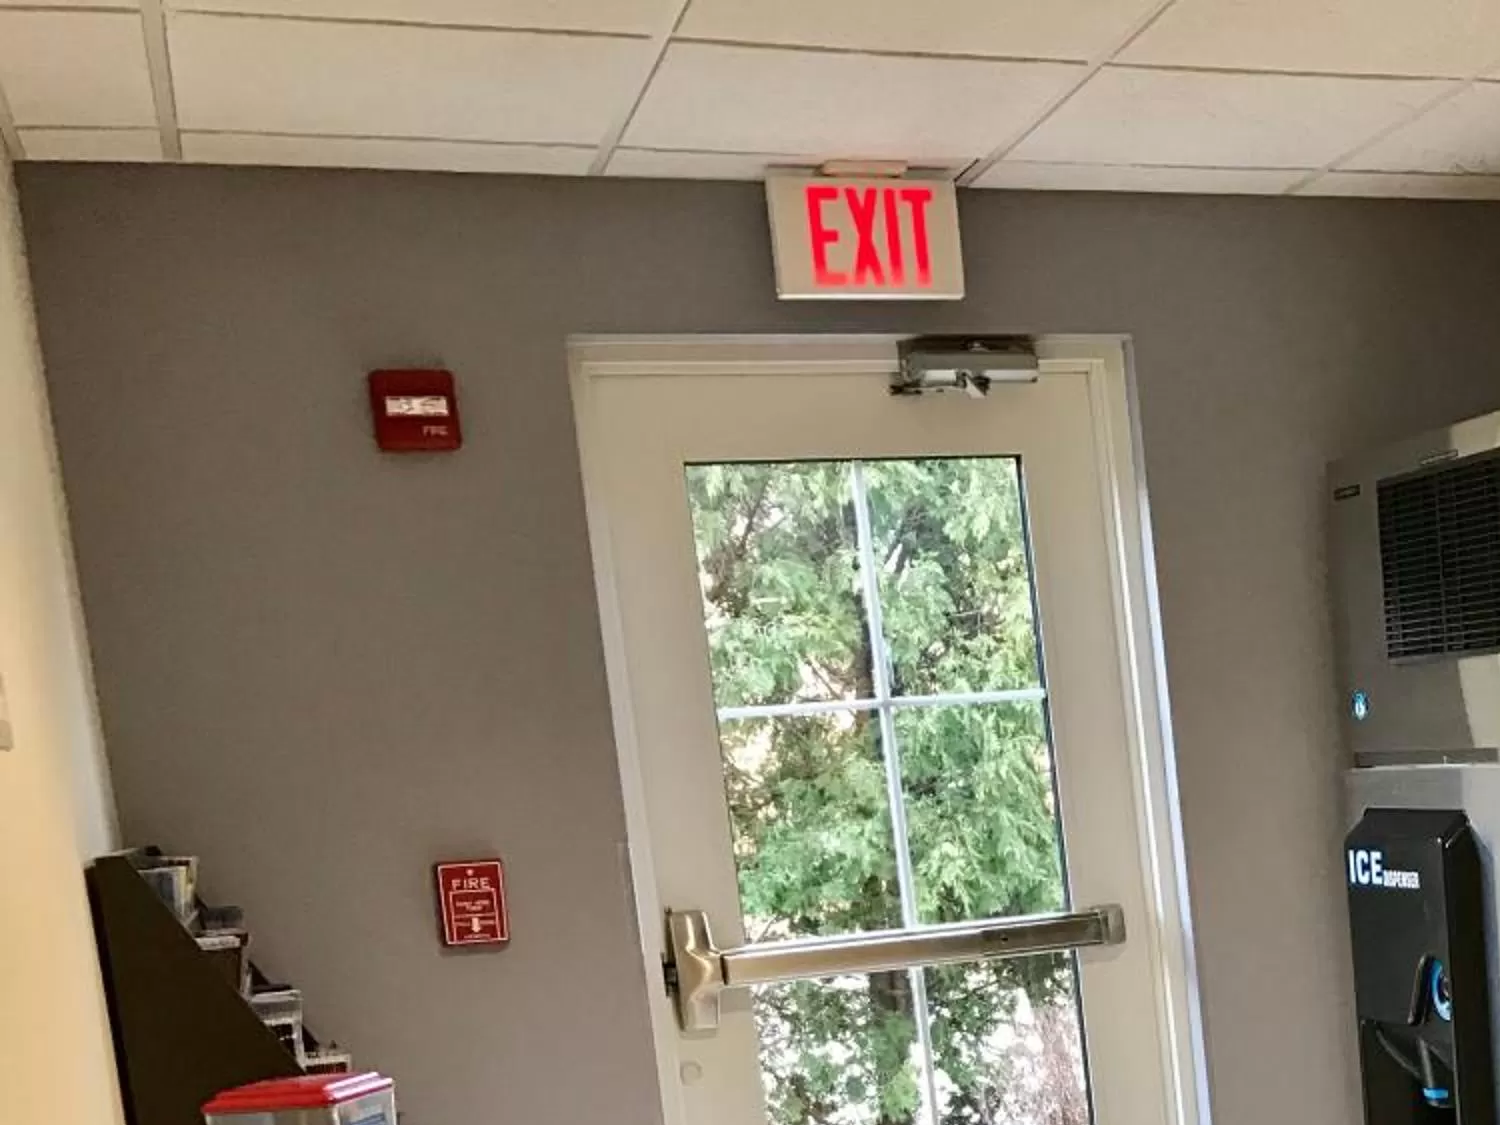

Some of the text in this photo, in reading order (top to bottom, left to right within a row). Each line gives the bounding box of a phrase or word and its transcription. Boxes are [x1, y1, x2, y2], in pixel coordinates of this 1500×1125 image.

[806, 186, 933, 287] EXIT
[451, 877, 491, 892] FIRE
[1347, 849, 1383, 885] ICE
